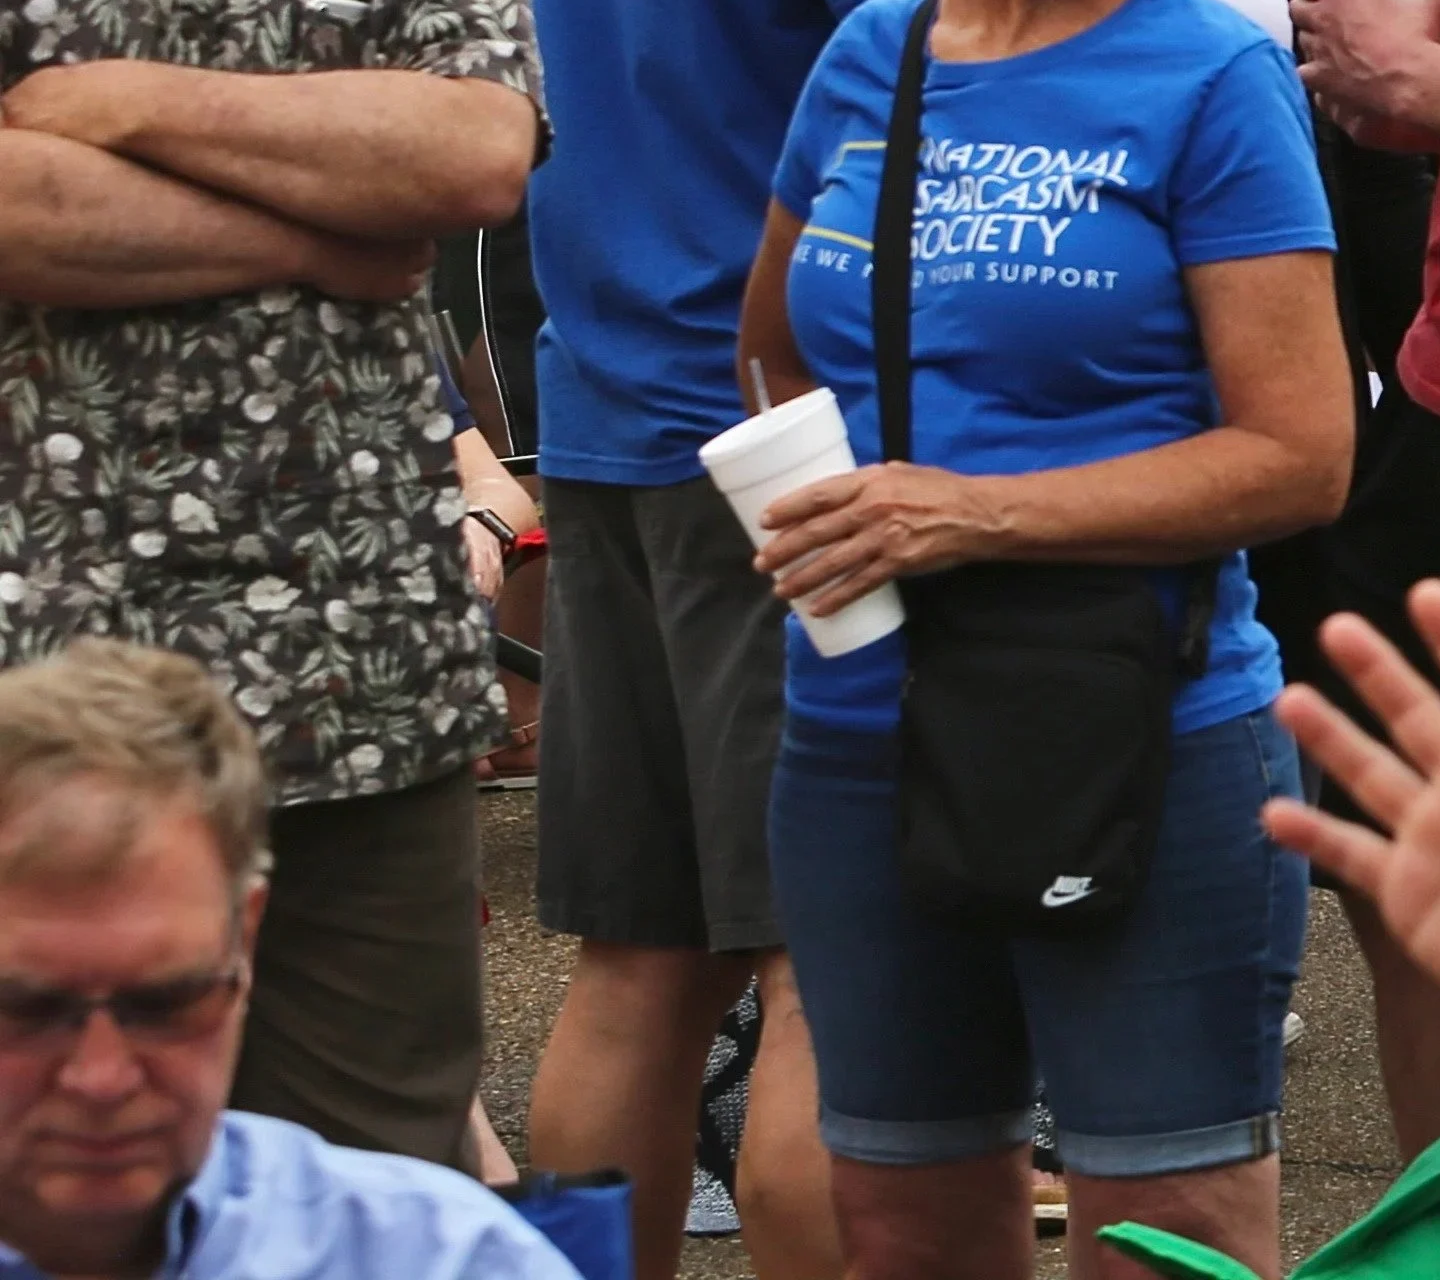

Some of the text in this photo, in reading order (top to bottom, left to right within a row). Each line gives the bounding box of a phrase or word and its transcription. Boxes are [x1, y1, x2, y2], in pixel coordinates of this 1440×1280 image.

[918, 136, 1130, 188] NATIONAL
[912, 175, 1102, 216] SARCASM
[910, 214, 1071, 257] SOCIETY
[983, 262, 1119, 291] SUPPORT
